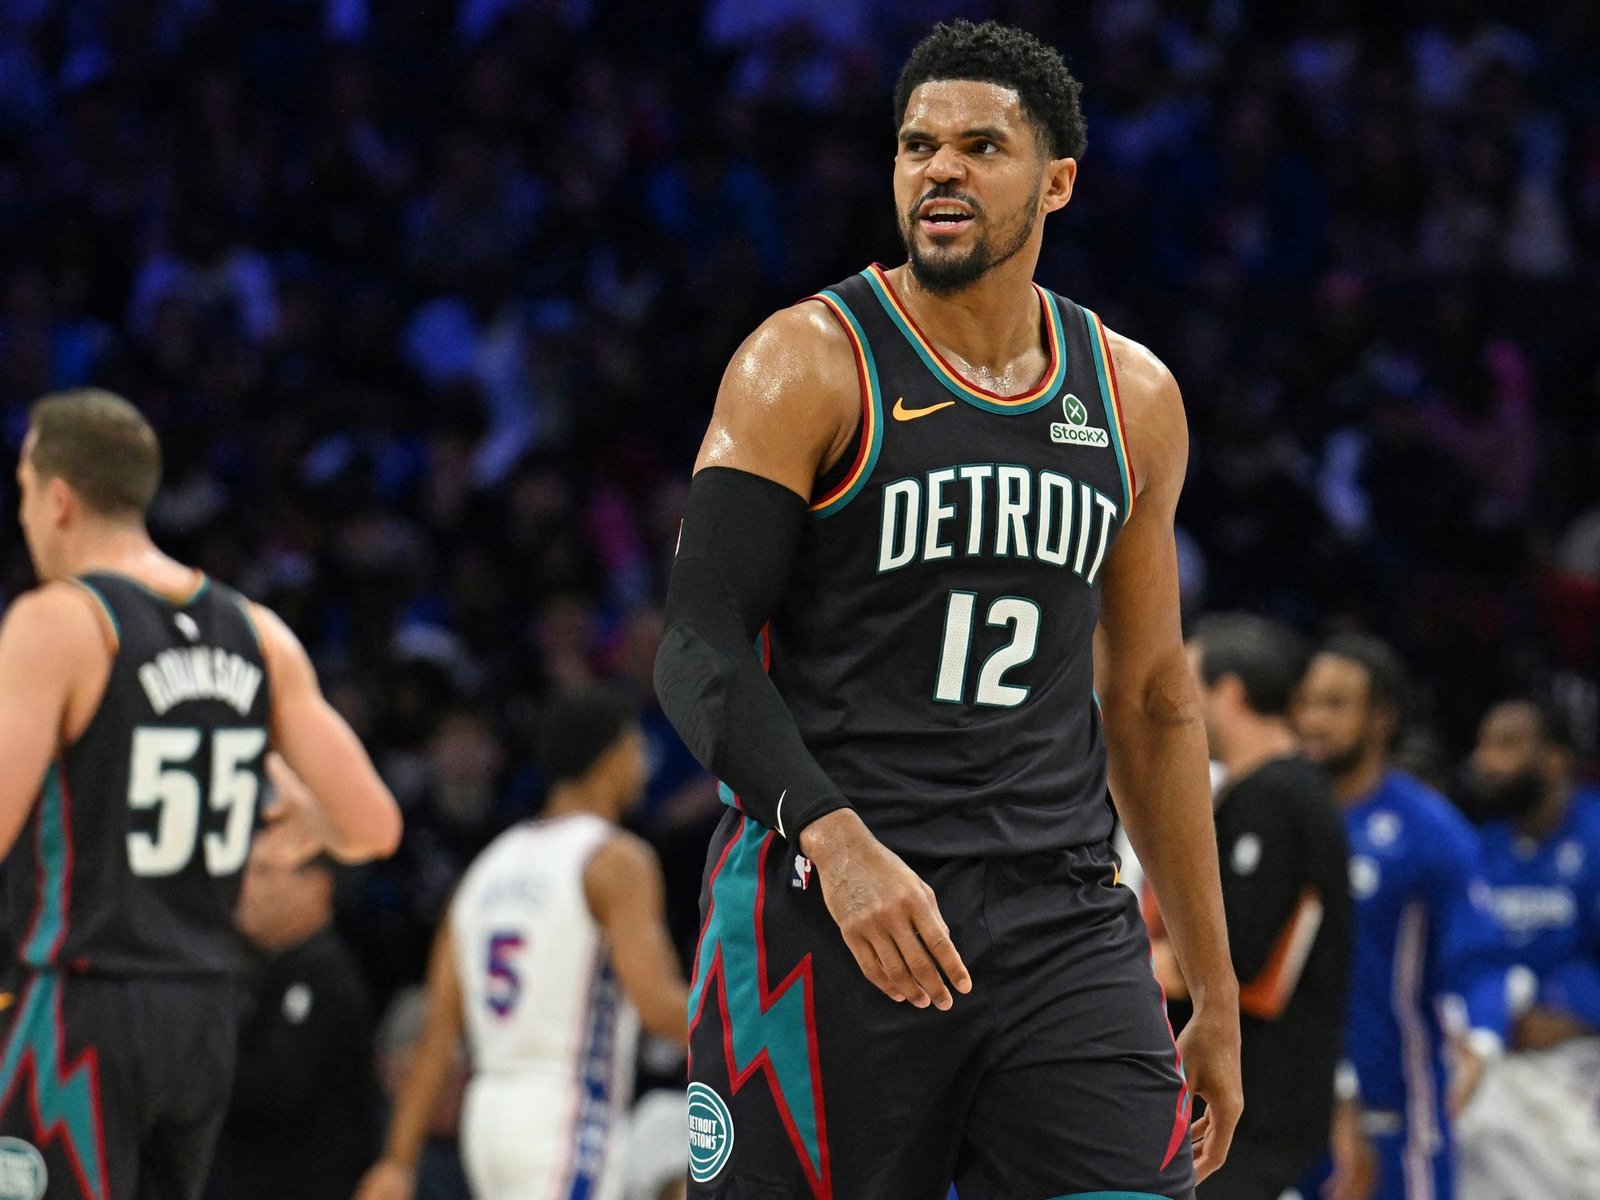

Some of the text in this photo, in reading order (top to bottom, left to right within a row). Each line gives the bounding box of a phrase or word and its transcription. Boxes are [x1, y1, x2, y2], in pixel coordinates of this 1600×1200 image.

[1053, 425, 1107, 445] StockX
[876, 463, 1117, 586] DETROIT
[933, 590, 1040, 706] 12
[127, 727, 266, 877] 55
[487, 931, 527, 1018] 5
